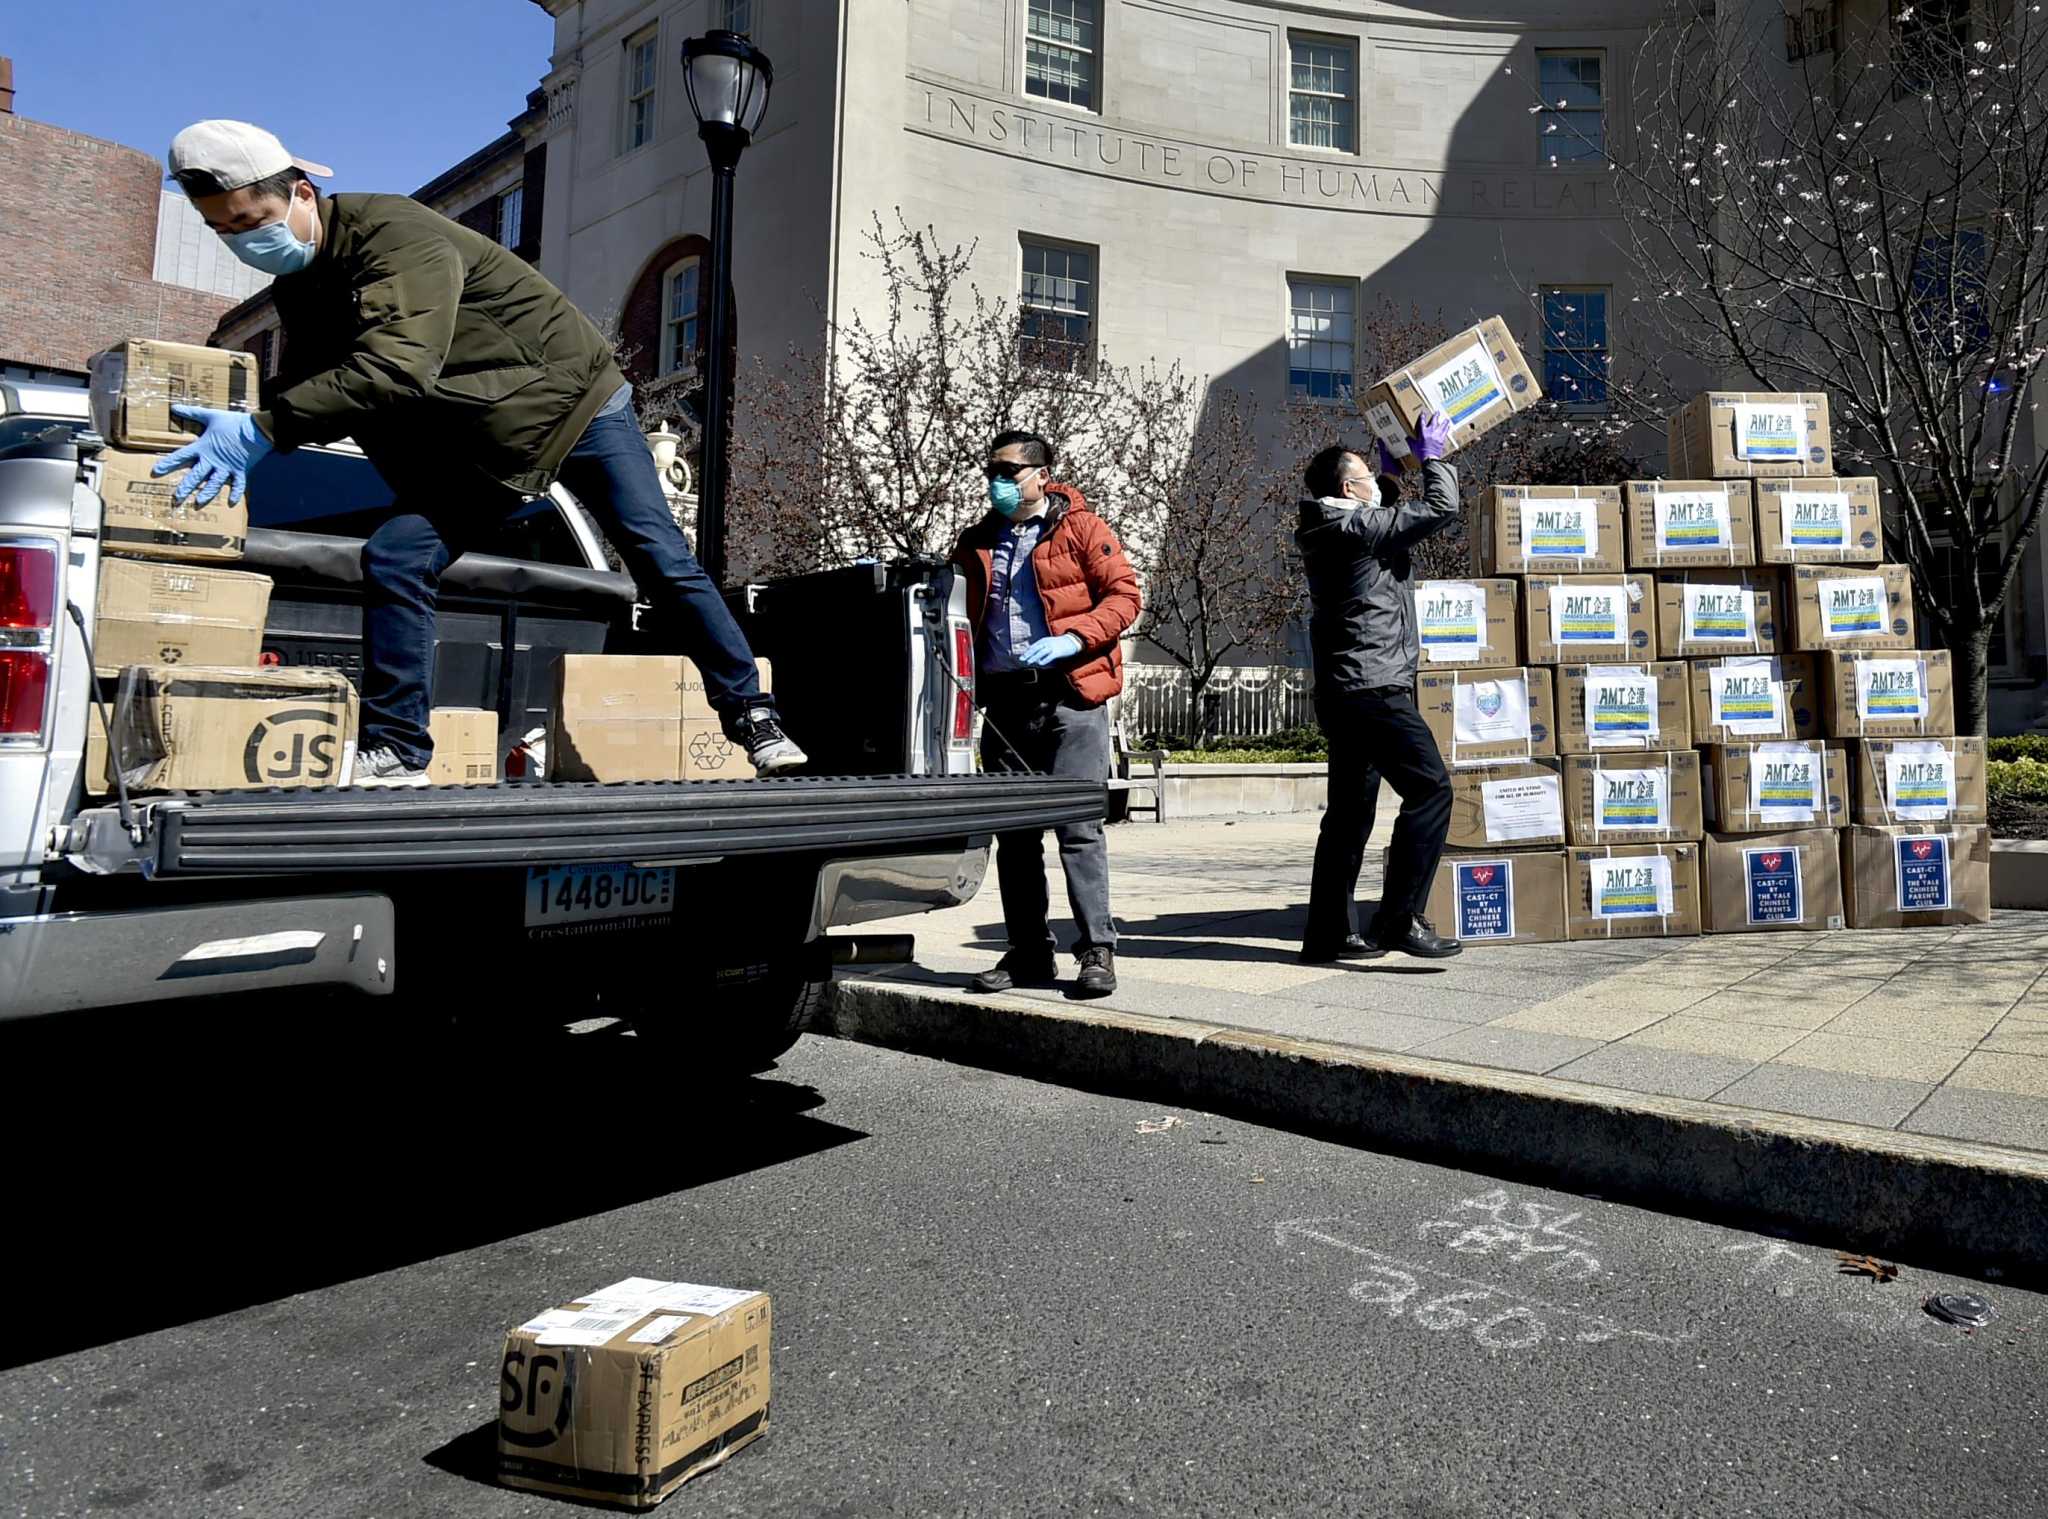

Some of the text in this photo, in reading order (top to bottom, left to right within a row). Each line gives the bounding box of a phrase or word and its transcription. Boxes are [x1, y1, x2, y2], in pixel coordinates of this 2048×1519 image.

[925, 90, 1183, 177] INSTITUTE
[1206, 154, 1261, 188] OF
[1281, 164, 1448, 206] HUMAN
[1438, 371, 1464, 400] AMT
[1751, 414, 1774, 431] AMT
[1536, 512, 1562, 528] AMT
[1669, 504, 1693, 521] AMT
[1795, 504, 1819, 520] AMT
[1566, 597, 1591, 614] AMT
[1698, 595, 1722, 612] AMT
[1833, 590, 1856, 607] AMT
[1426, 600, 1452, 617] AMT
[1725, 678, 1749, 695] AMT
[1871, 672, 1895, 689] AMT
[1600, 688, 1625, 705] AMT
[1765, 764, 1790, 781] AMT
[1900, 764, 1924, 781] AMT
[1608, 781, 1634, 799] AMT
[1606, 869, 1632, 887] AMT
[501, 1351, 559, 1416] SF
[635, 1391, 653, 1465] EXPRESS
